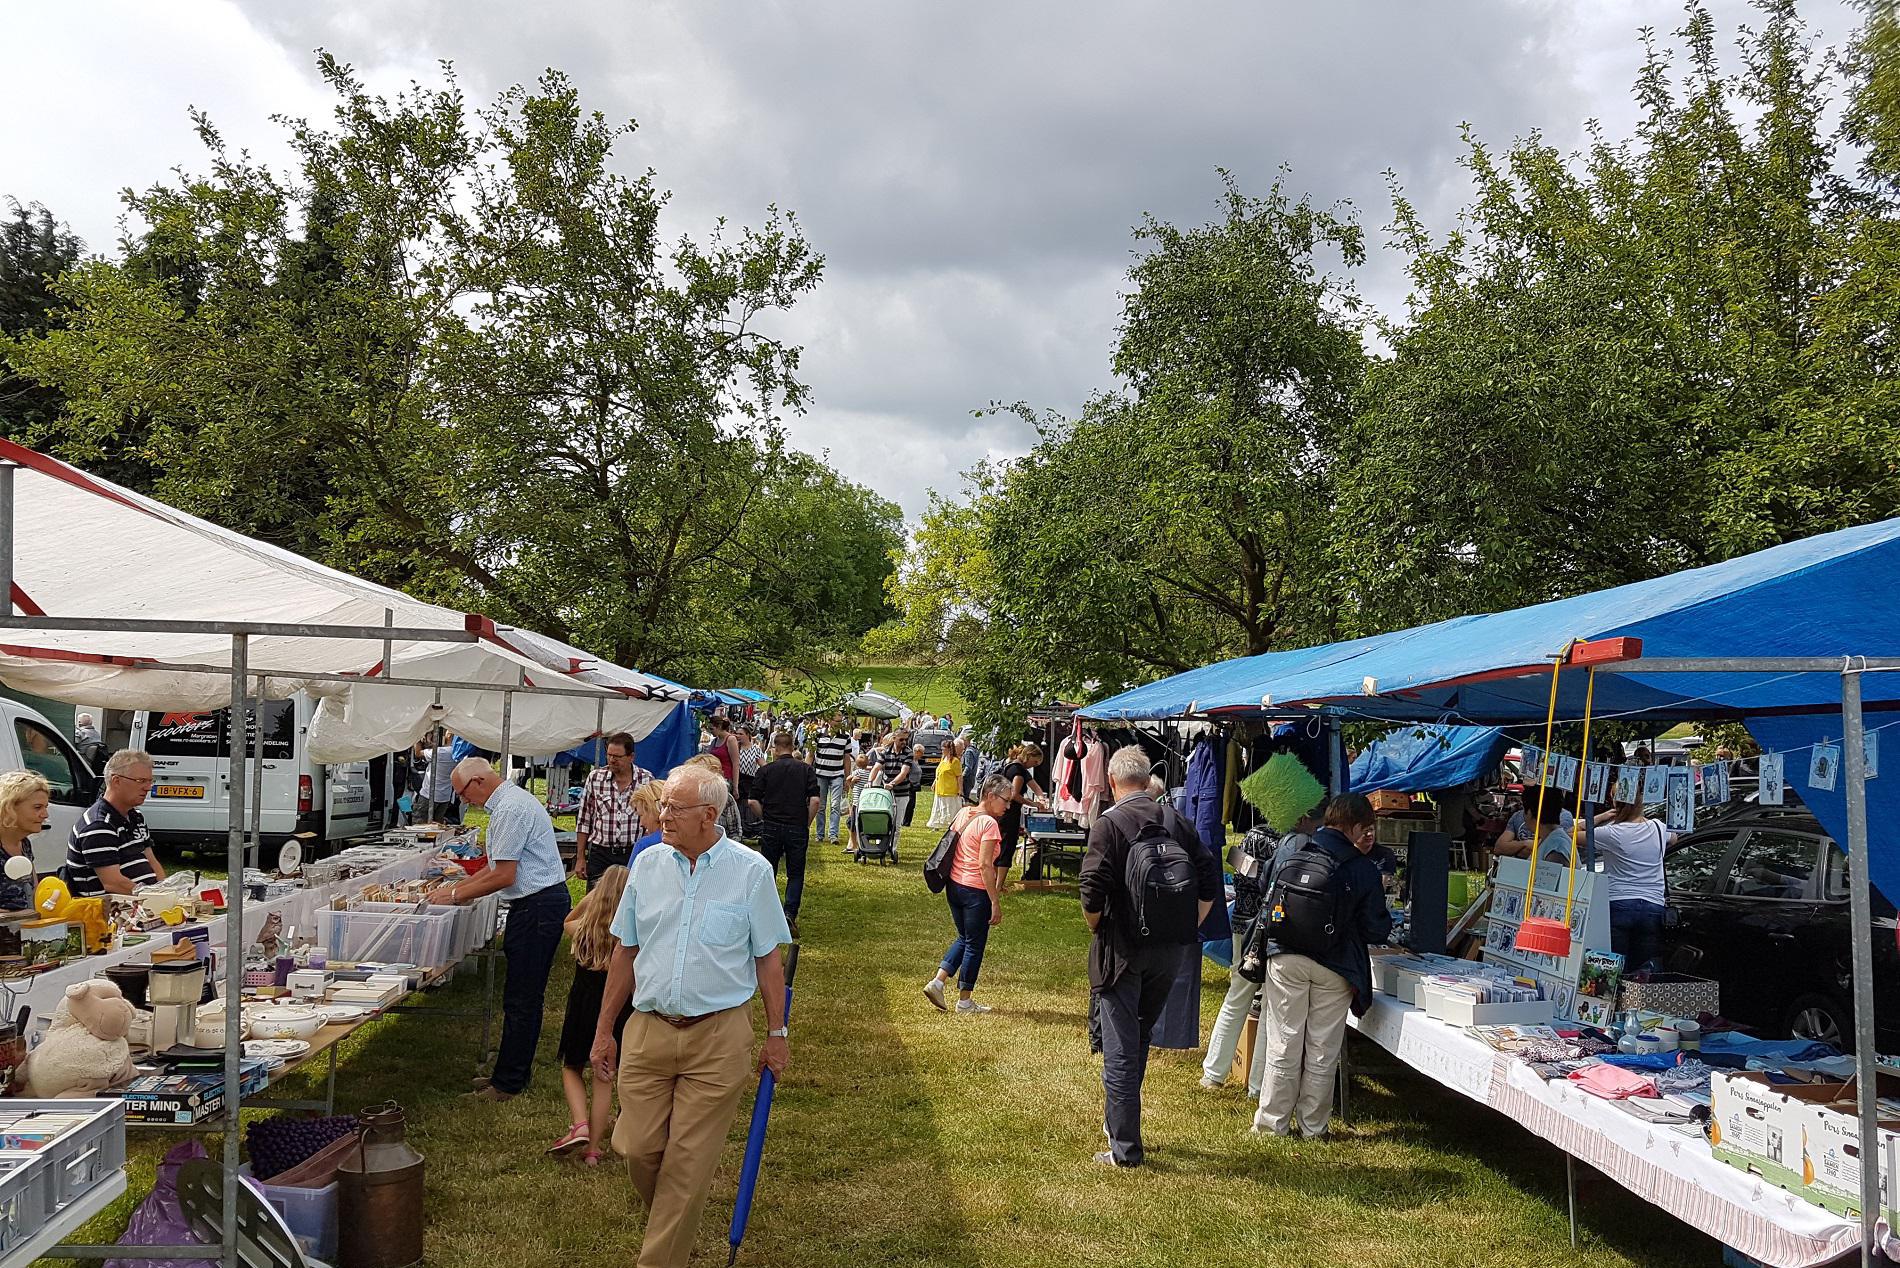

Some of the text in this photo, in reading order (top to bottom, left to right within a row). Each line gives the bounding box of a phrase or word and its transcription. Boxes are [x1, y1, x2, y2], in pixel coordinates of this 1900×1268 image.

[160, 786, 198, 796] 18-VFX-6
[1730, 1086, 1744, 1100] Pers
[150, 1100, 181, 1111] MIND
[195, 1096, 221, 1120] MASTER
[1824, 1120, 1840, 1135] Pers
